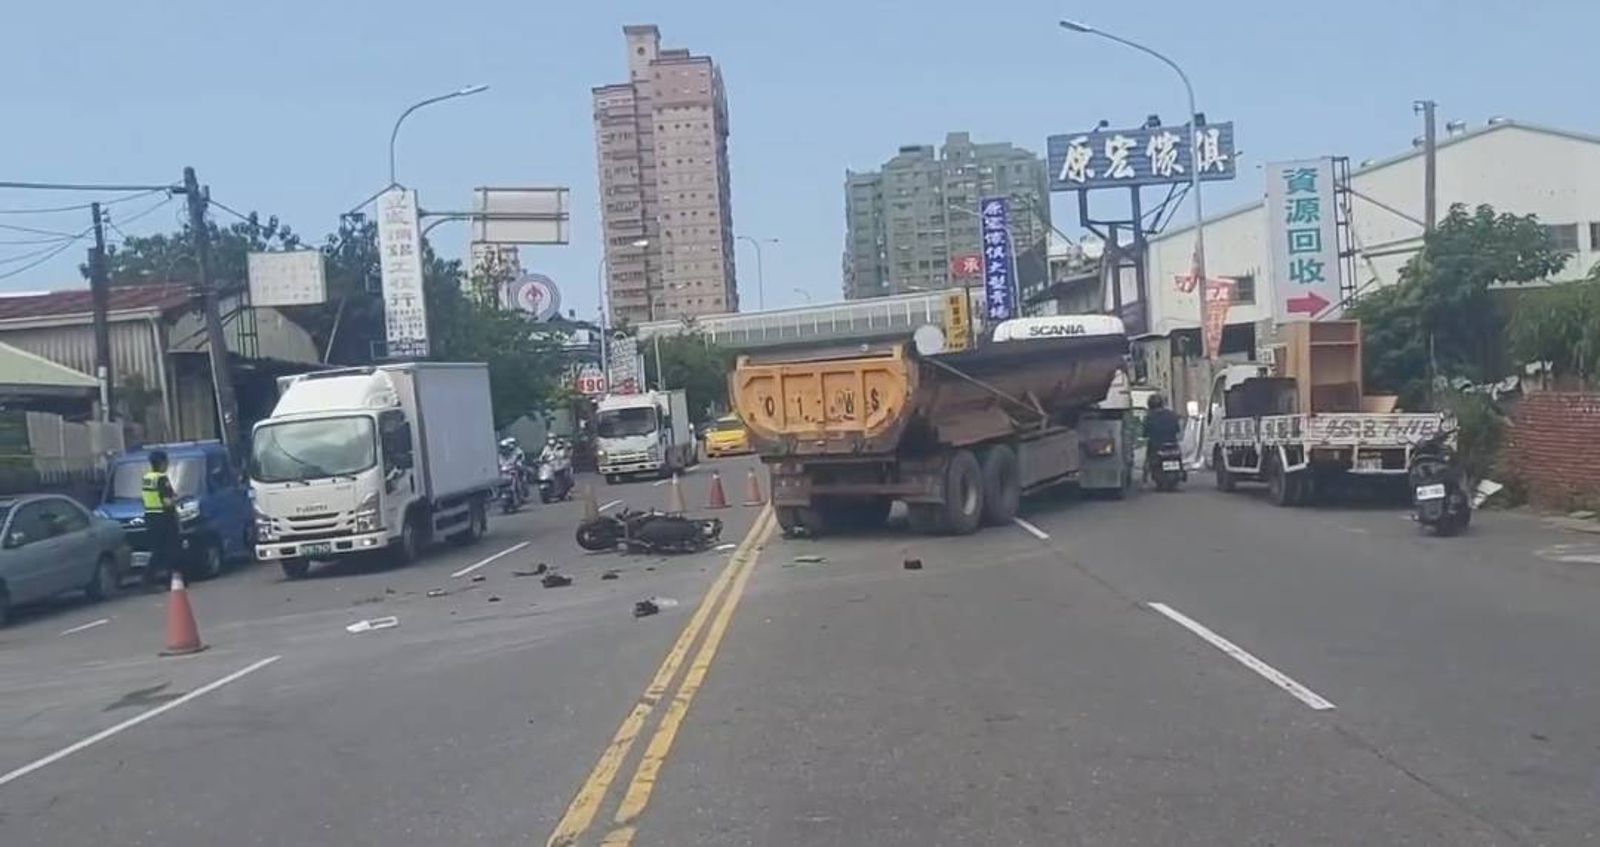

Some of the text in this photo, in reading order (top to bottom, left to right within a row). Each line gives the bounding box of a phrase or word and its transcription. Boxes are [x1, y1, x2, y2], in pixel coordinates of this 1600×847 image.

[1059, 128, 1228, 183] 原宏傢俱
[1282, 167, 1325, 284] 資源回收
[1030, 324, 1086, 336] SCANIA
